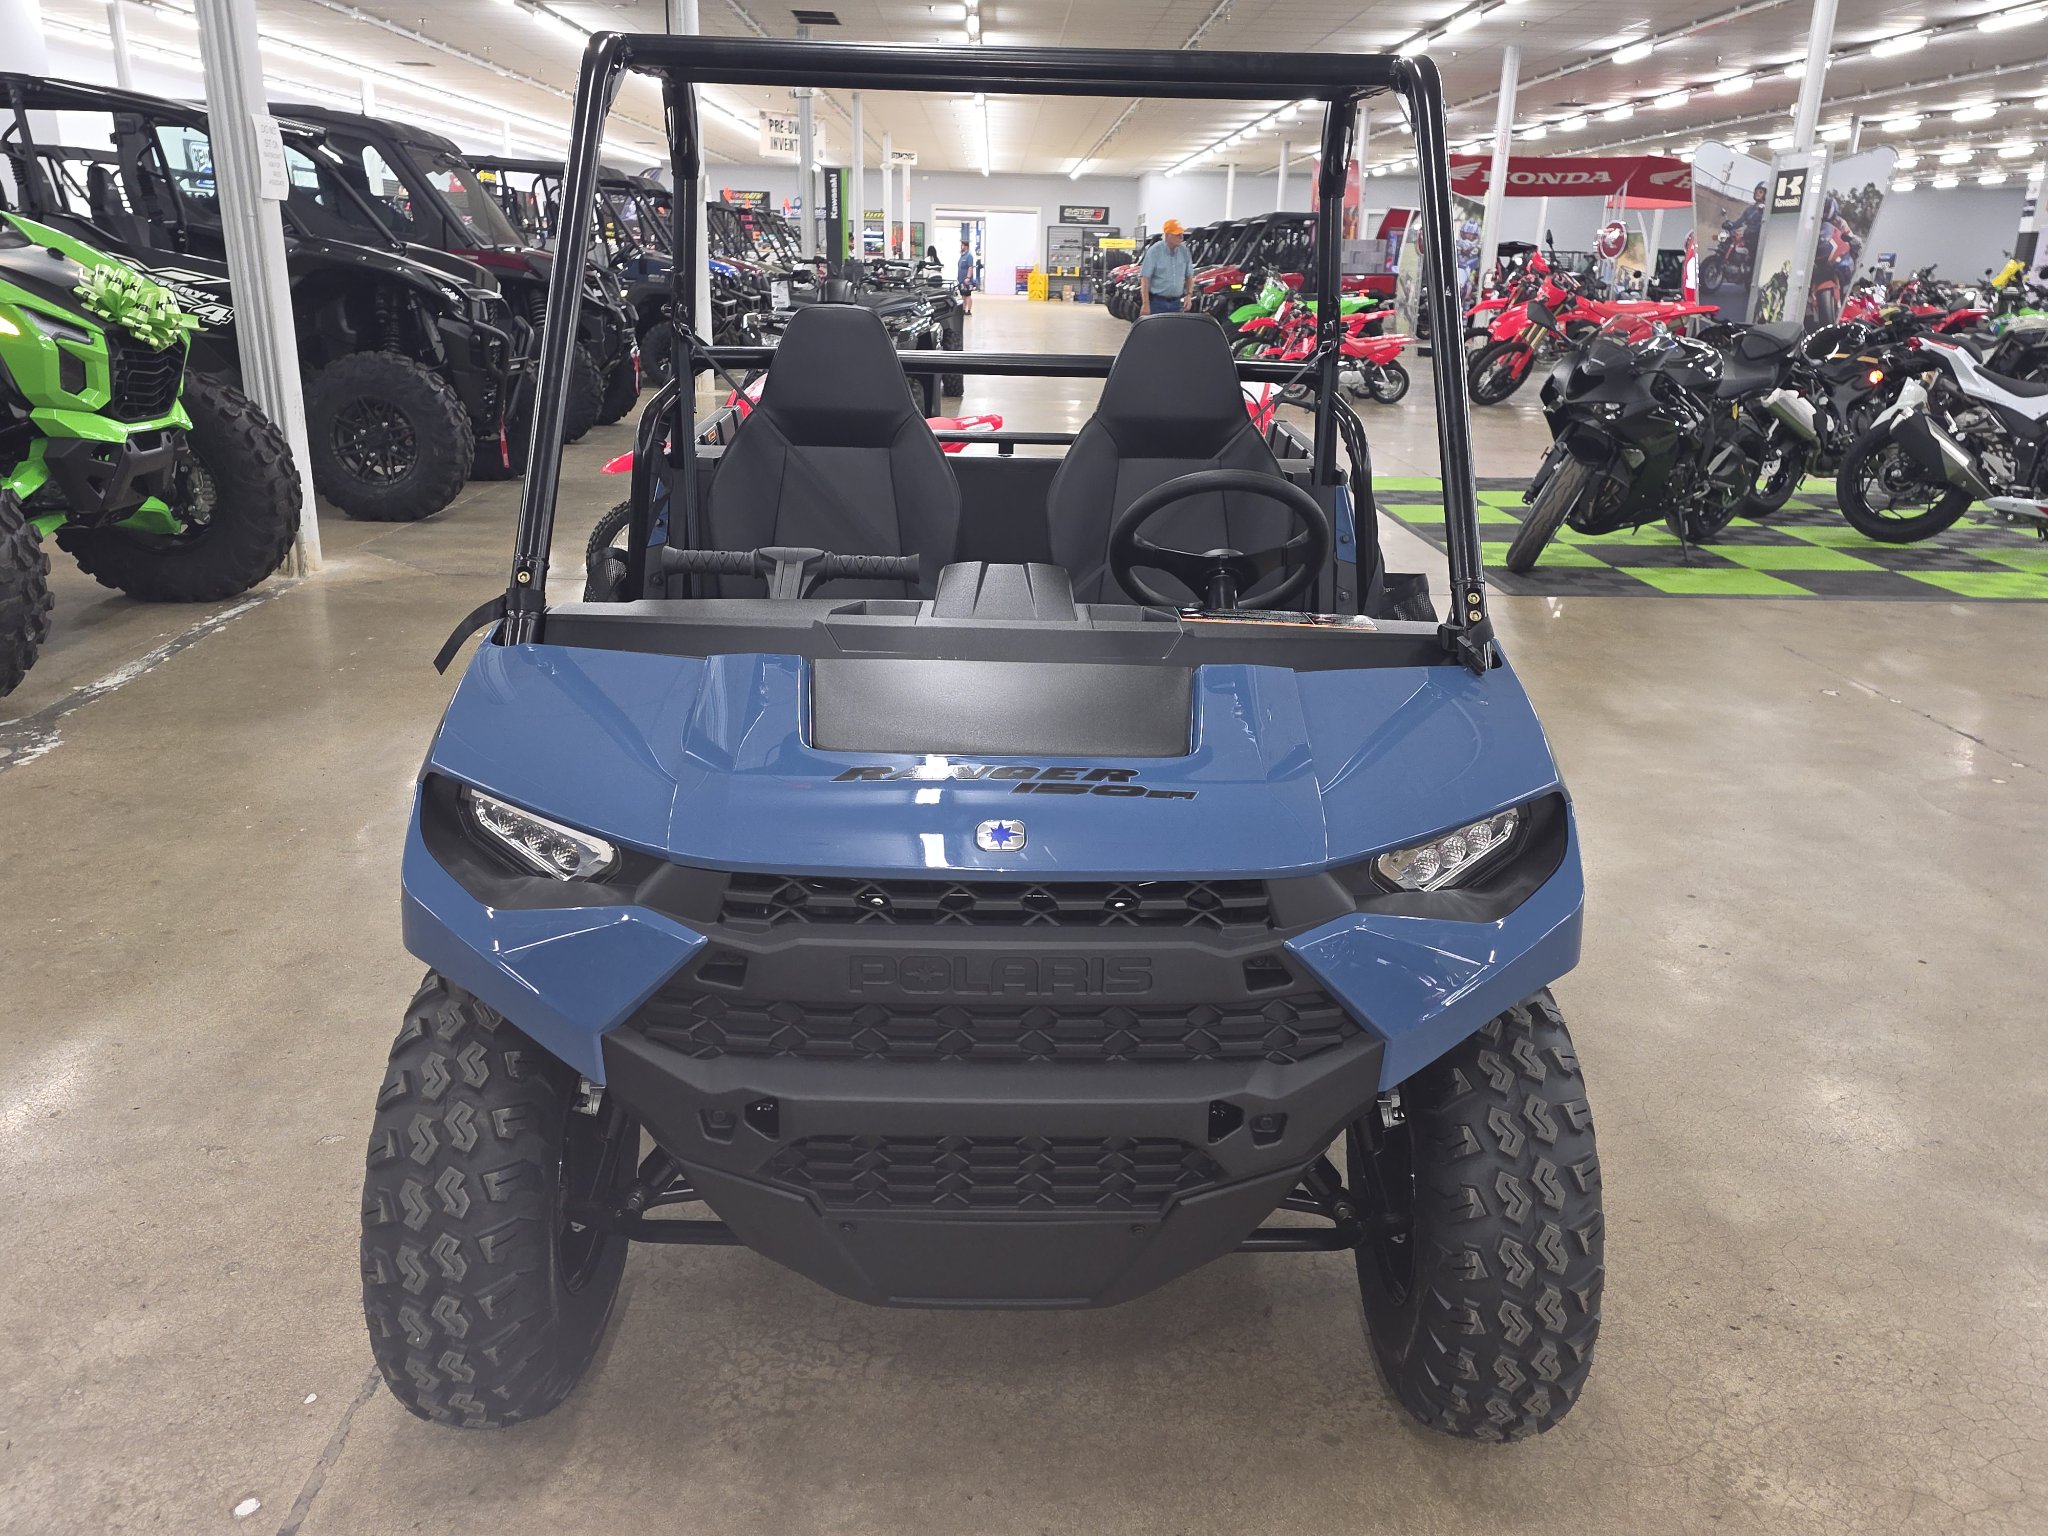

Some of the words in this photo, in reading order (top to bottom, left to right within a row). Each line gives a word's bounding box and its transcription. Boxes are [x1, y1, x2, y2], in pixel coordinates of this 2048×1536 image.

[830, 173, 838, 219] Kawasaki
[829, 764, 1141, 783] RANGER
[849, 955, 1154, 996] POLARIS
